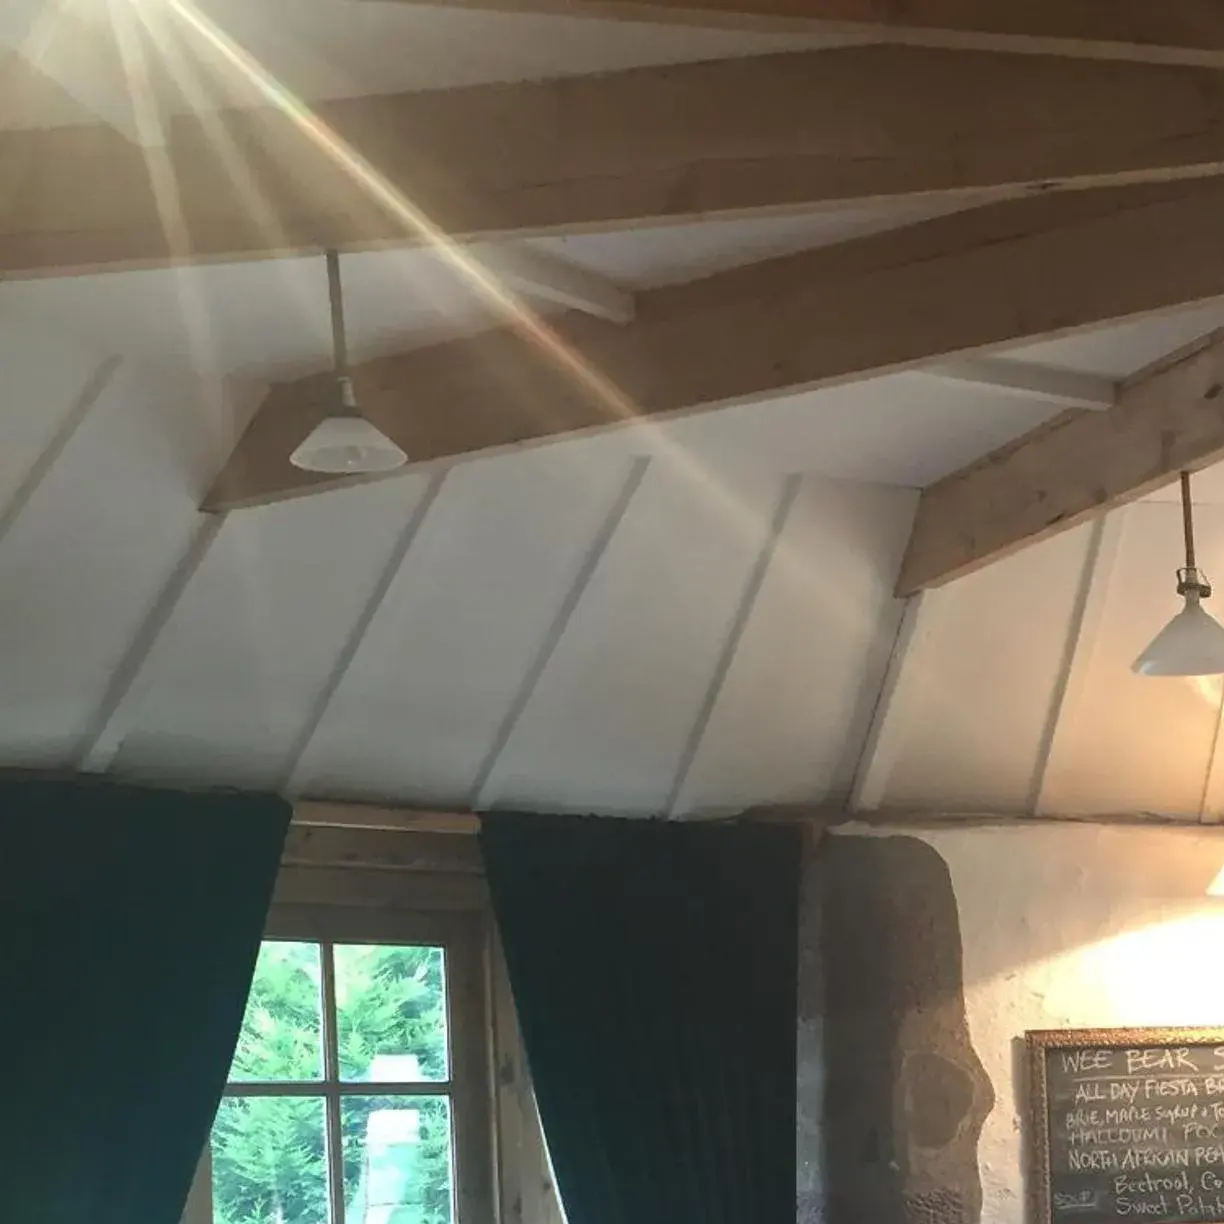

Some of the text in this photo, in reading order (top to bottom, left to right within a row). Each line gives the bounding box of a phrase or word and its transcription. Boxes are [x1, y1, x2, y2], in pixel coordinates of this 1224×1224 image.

[1062, 1049, 1113, 1073] WEE
[1125, 1047, 1199, 1074] BEAR
[1075, 1082, 1107, 1104] ALL
[1110, 1080, 1139, 1103] DAY
[1145, 1078, 1198, 1099] FIESTA
[1105, 1105, 1151, 1125] MAPLE
[1068, 1149, 1118, 1170] NORTH
[1121, 1147, 1189, 1169] AFRICAN
